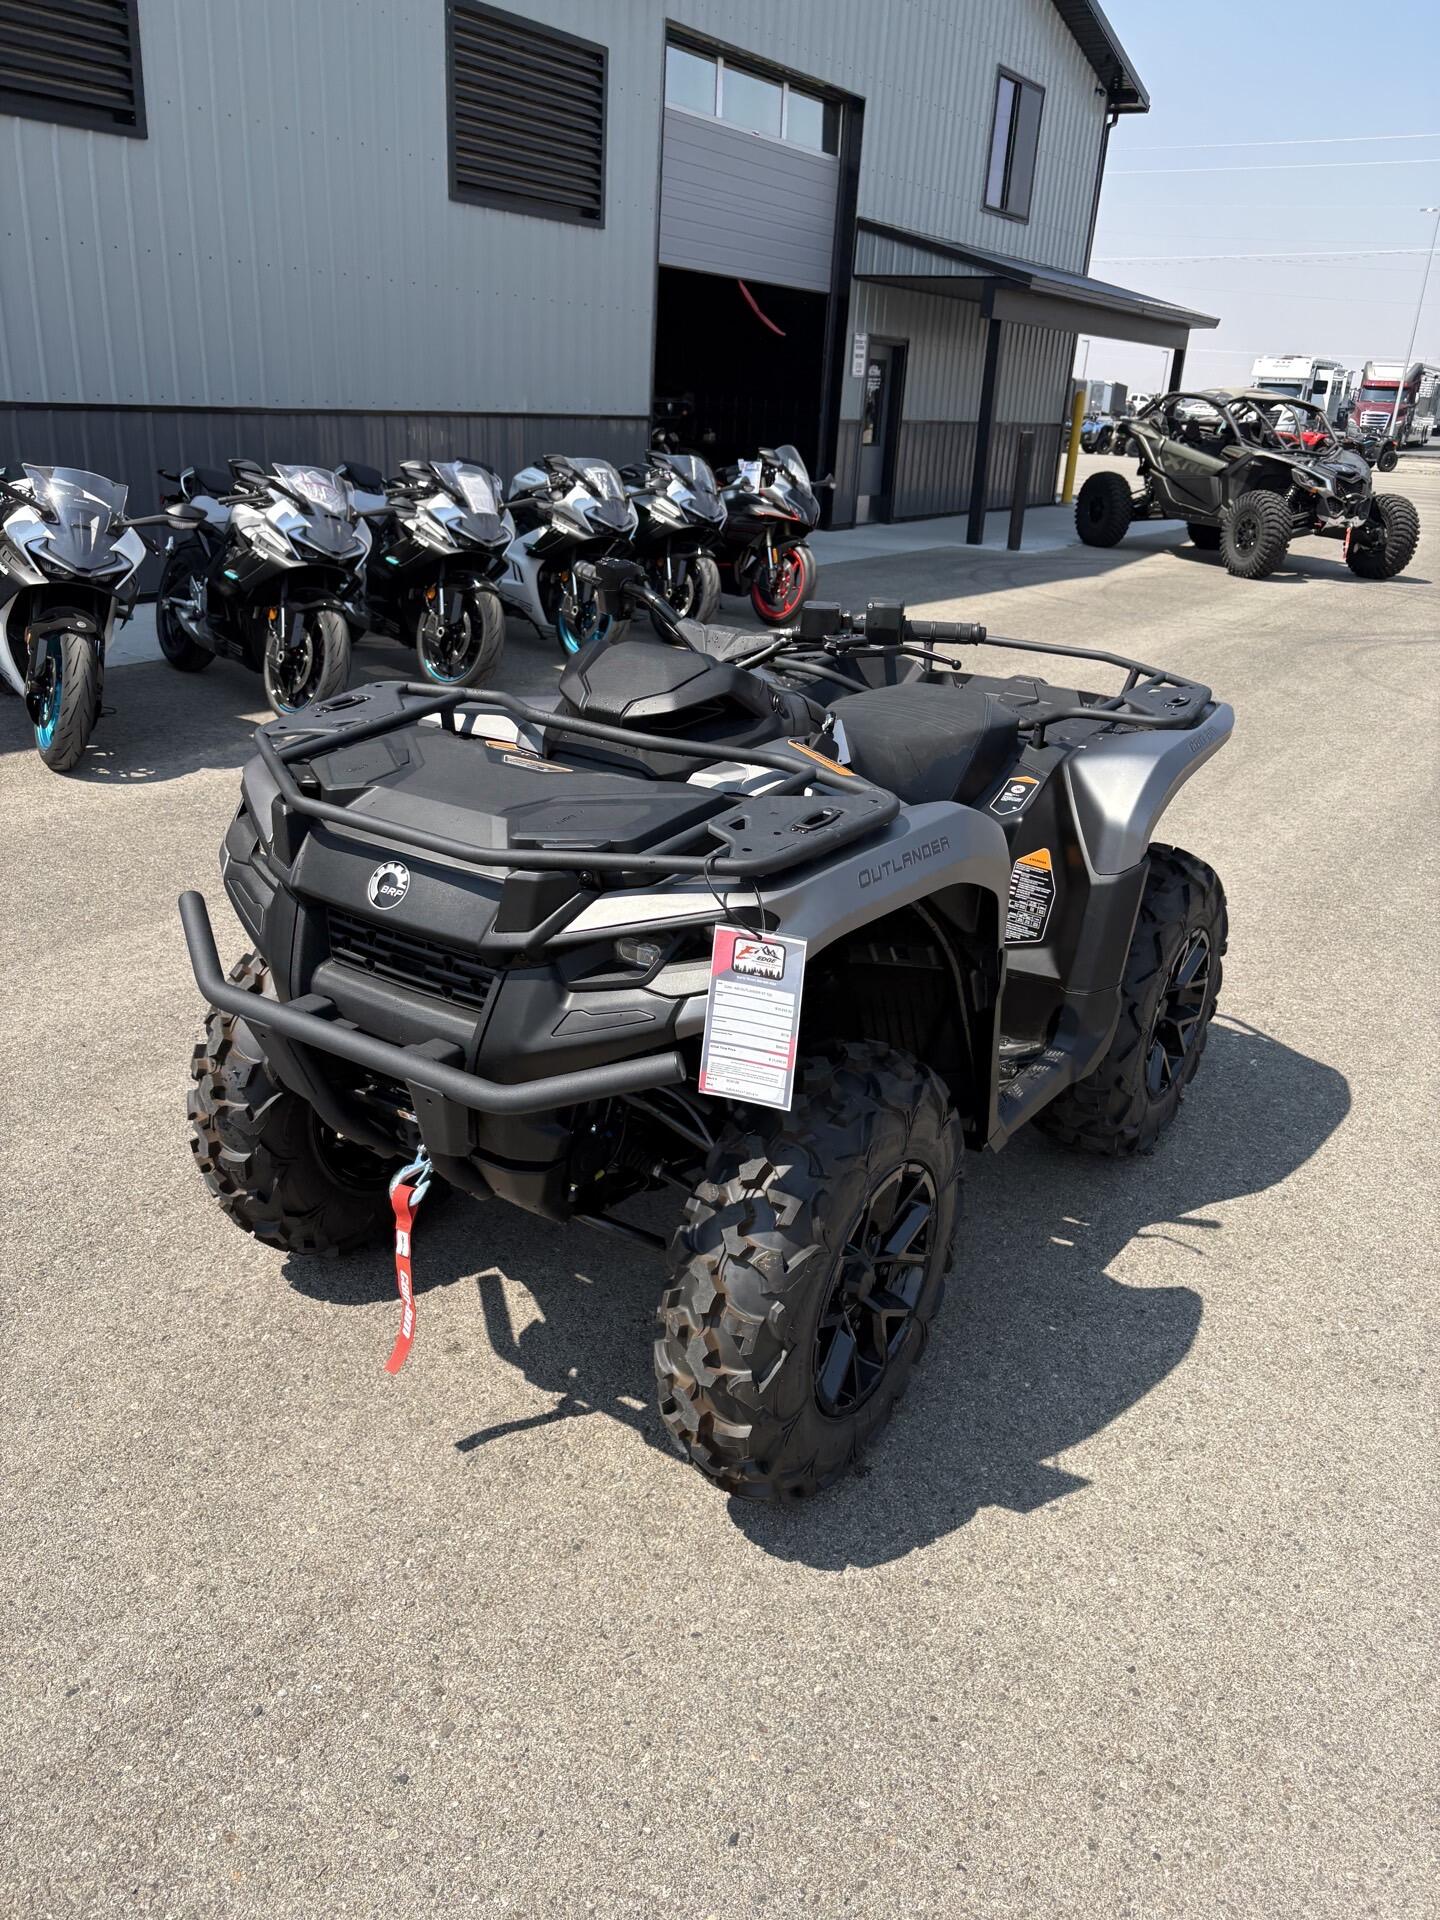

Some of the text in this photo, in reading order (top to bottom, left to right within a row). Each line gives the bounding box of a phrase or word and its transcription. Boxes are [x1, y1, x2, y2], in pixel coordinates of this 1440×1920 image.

[858, 836, 950, 888] OUTLANDER
[380, 885, 404, 897] BRP
[756, 956, 777, 964] EDGE
